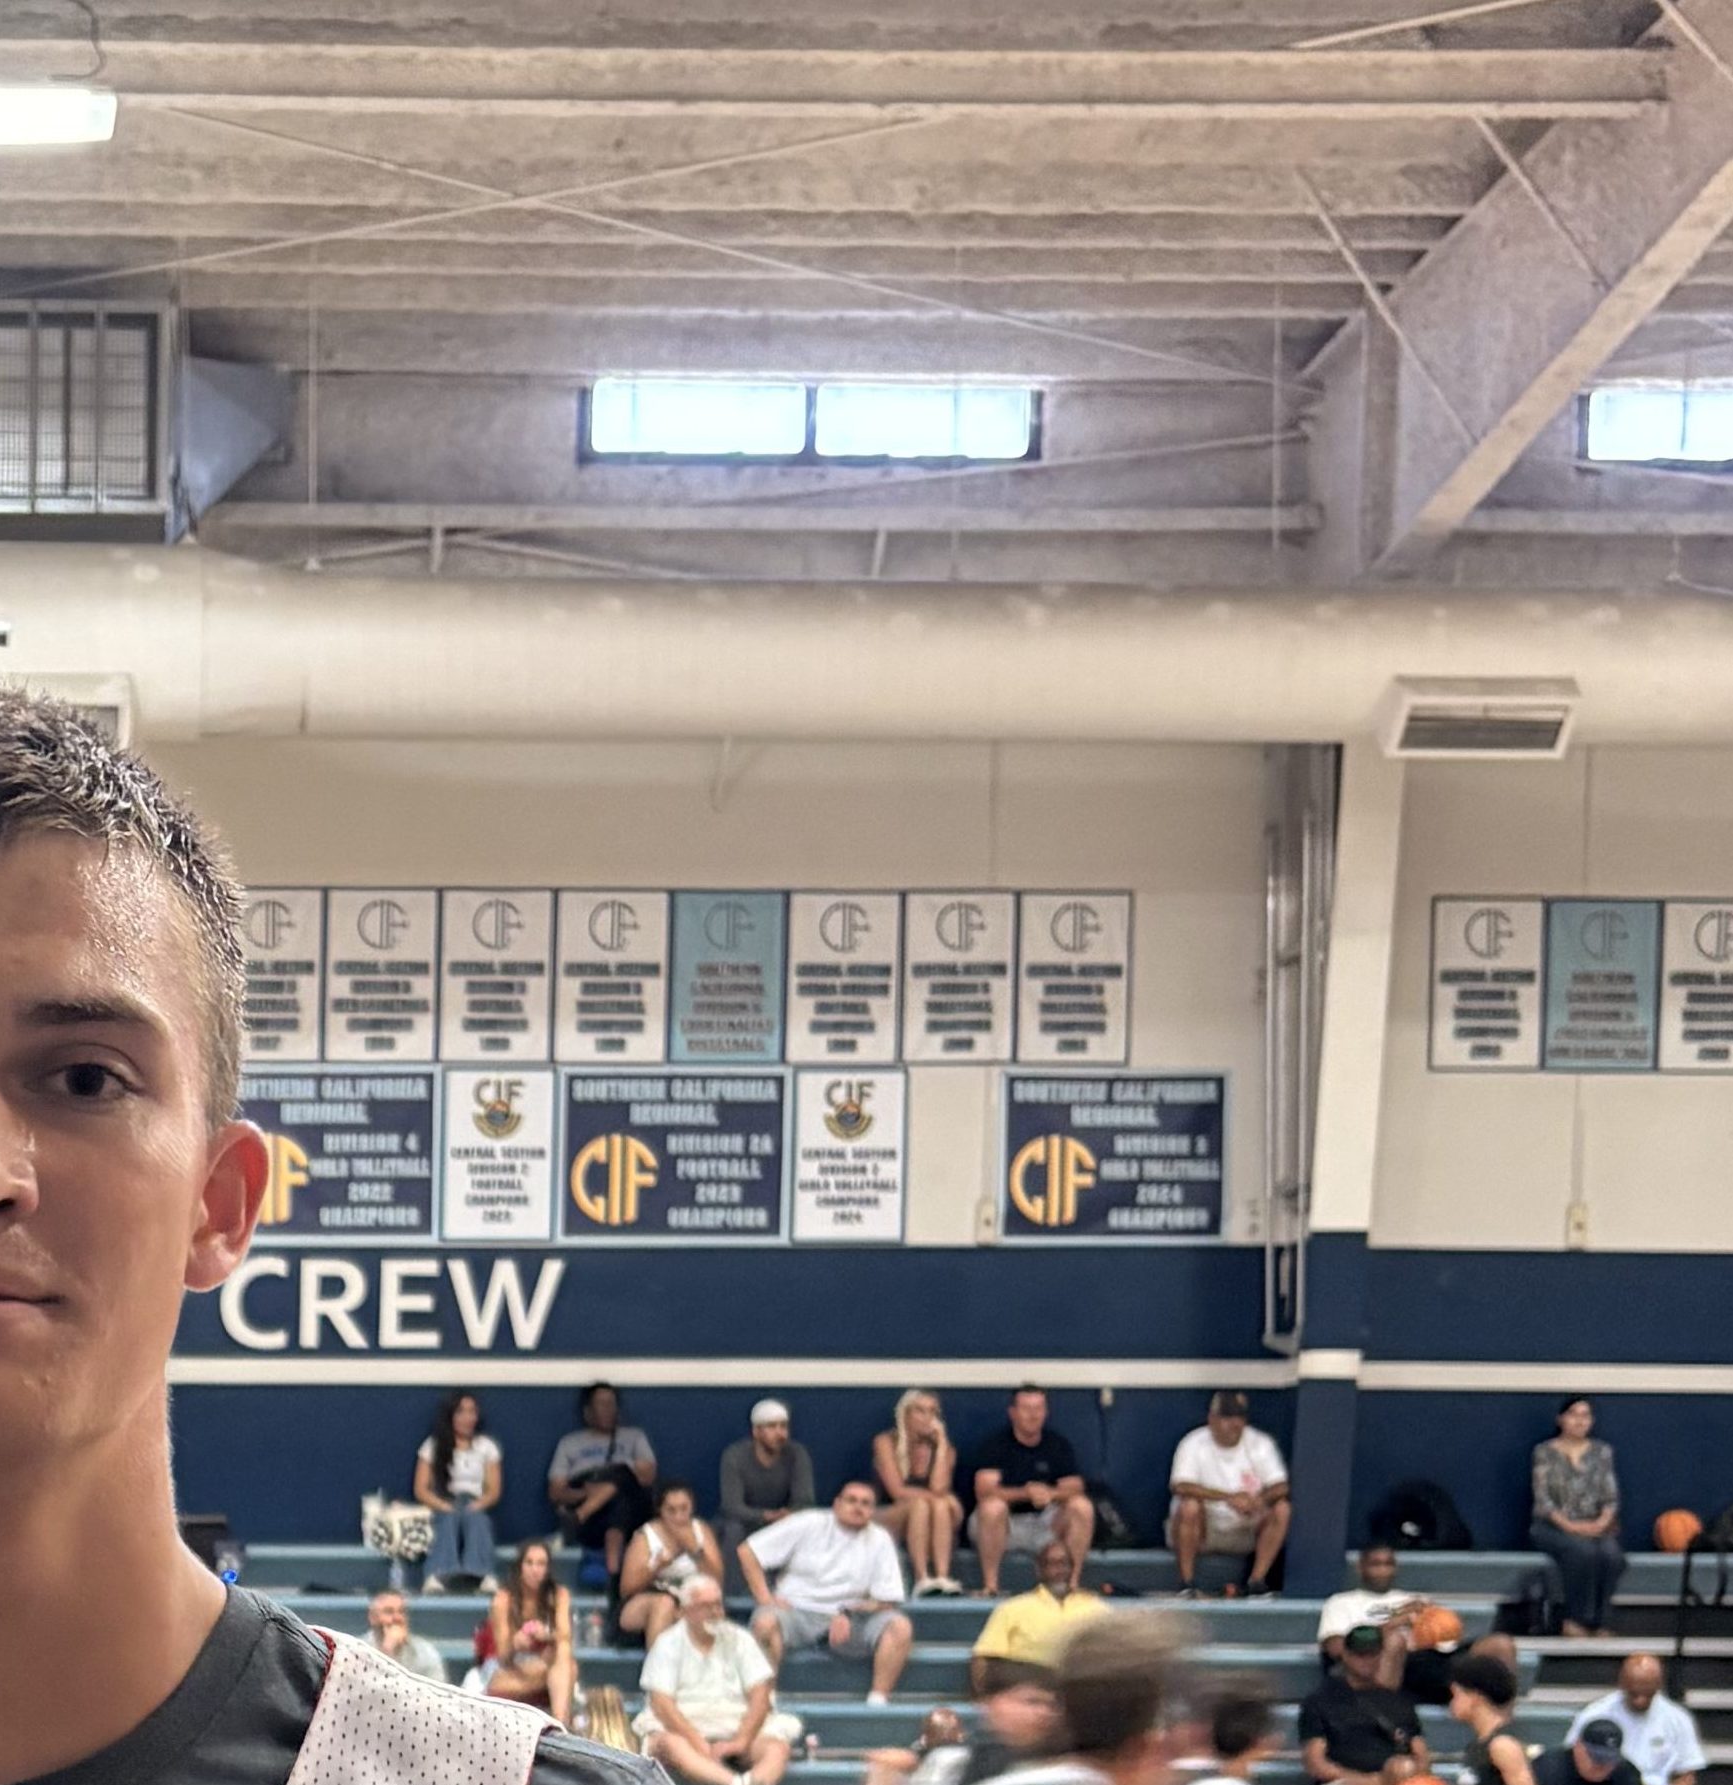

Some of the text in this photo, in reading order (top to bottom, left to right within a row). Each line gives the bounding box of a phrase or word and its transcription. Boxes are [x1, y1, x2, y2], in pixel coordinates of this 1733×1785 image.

[571, 1133, 659, 1226] CIF
[1010, 1135, 1097, 1227] CIF
[219, 1255, 564, 1351] CREW
